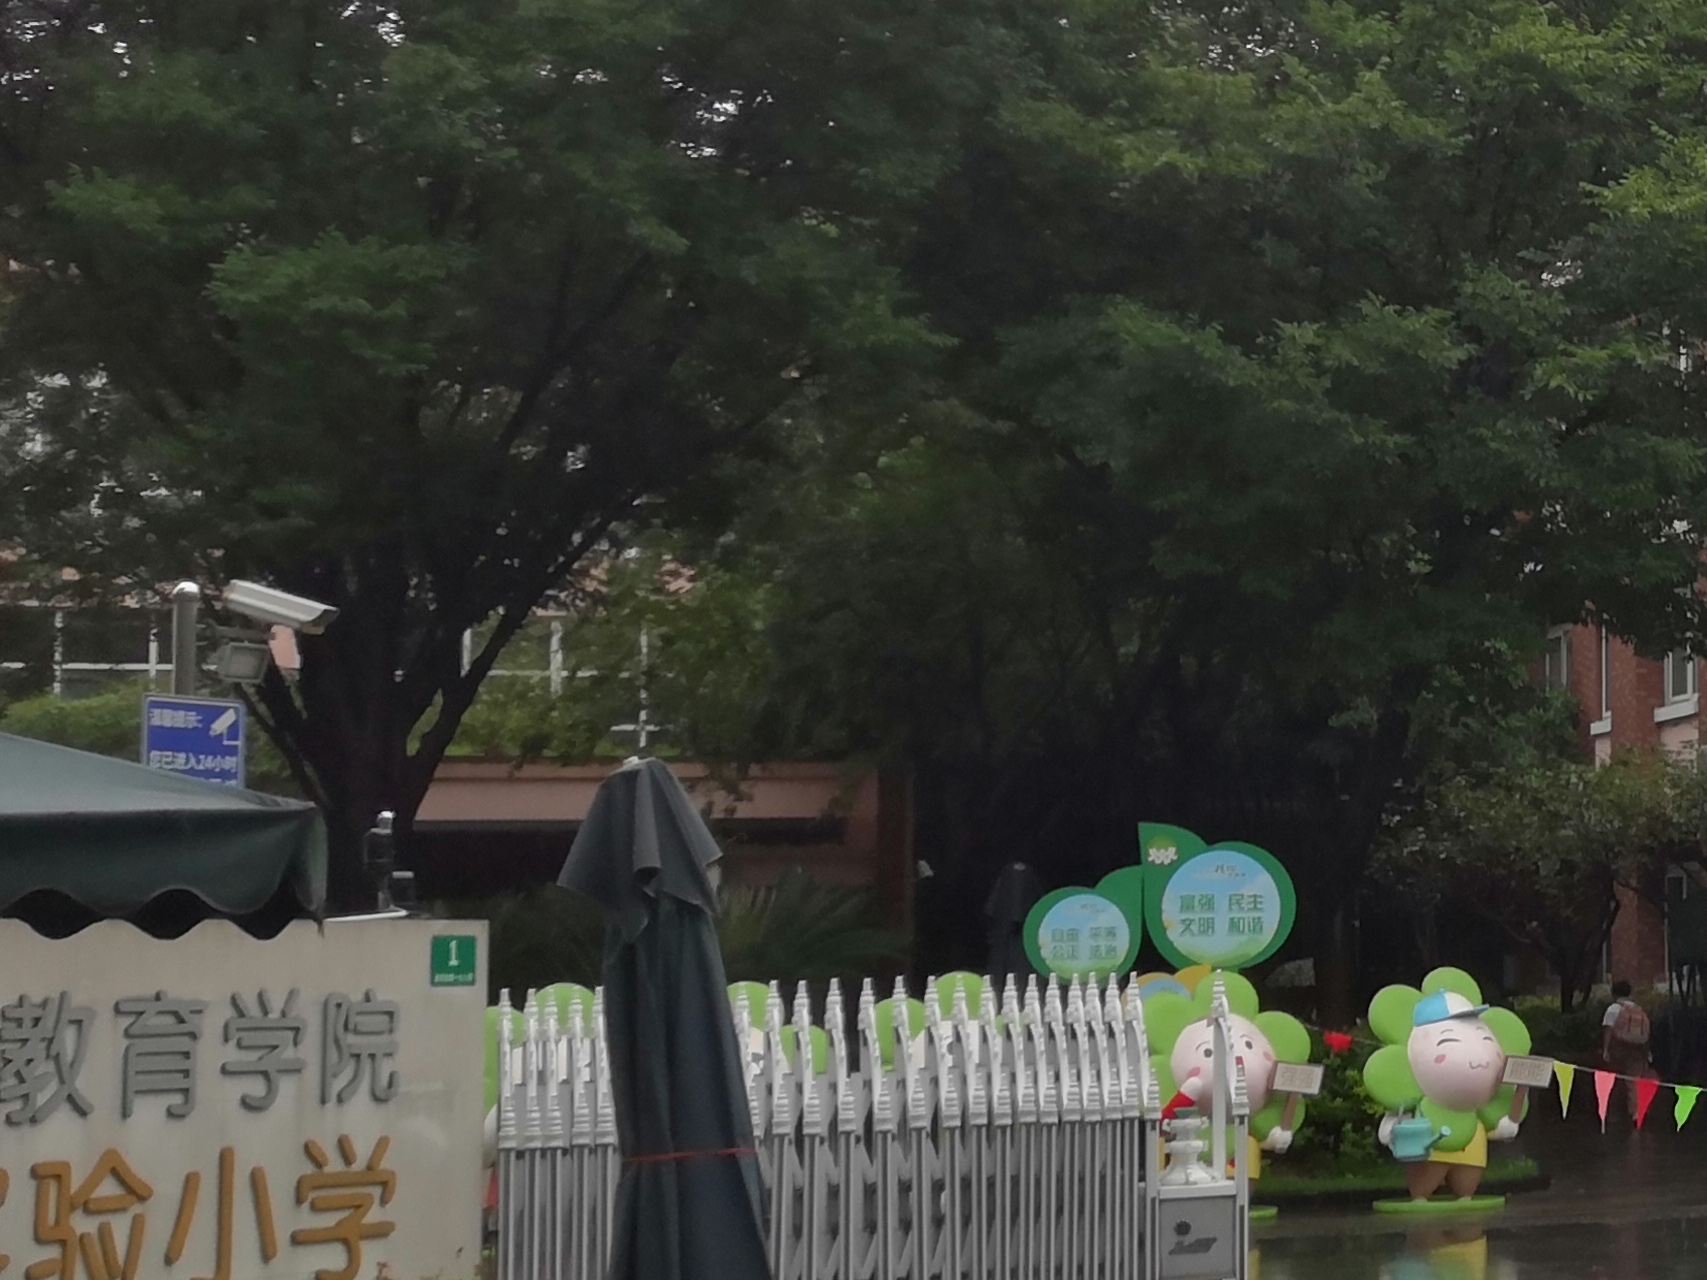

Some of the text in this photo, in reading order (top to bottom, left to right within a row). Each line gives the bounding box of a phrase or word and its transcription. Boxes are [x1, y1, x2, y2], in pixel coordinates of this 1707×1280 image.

[1179, 894, 1264, 913] 富强 民主
[1051, 927, 1080, 943] 自由
[1179, 917, 1264, 937] 文明 和谐
[448, 940, 460, 966] 1
[1051, 944, 1080, 960] 公正
[0, 989, 400, 1125] 教育学院
